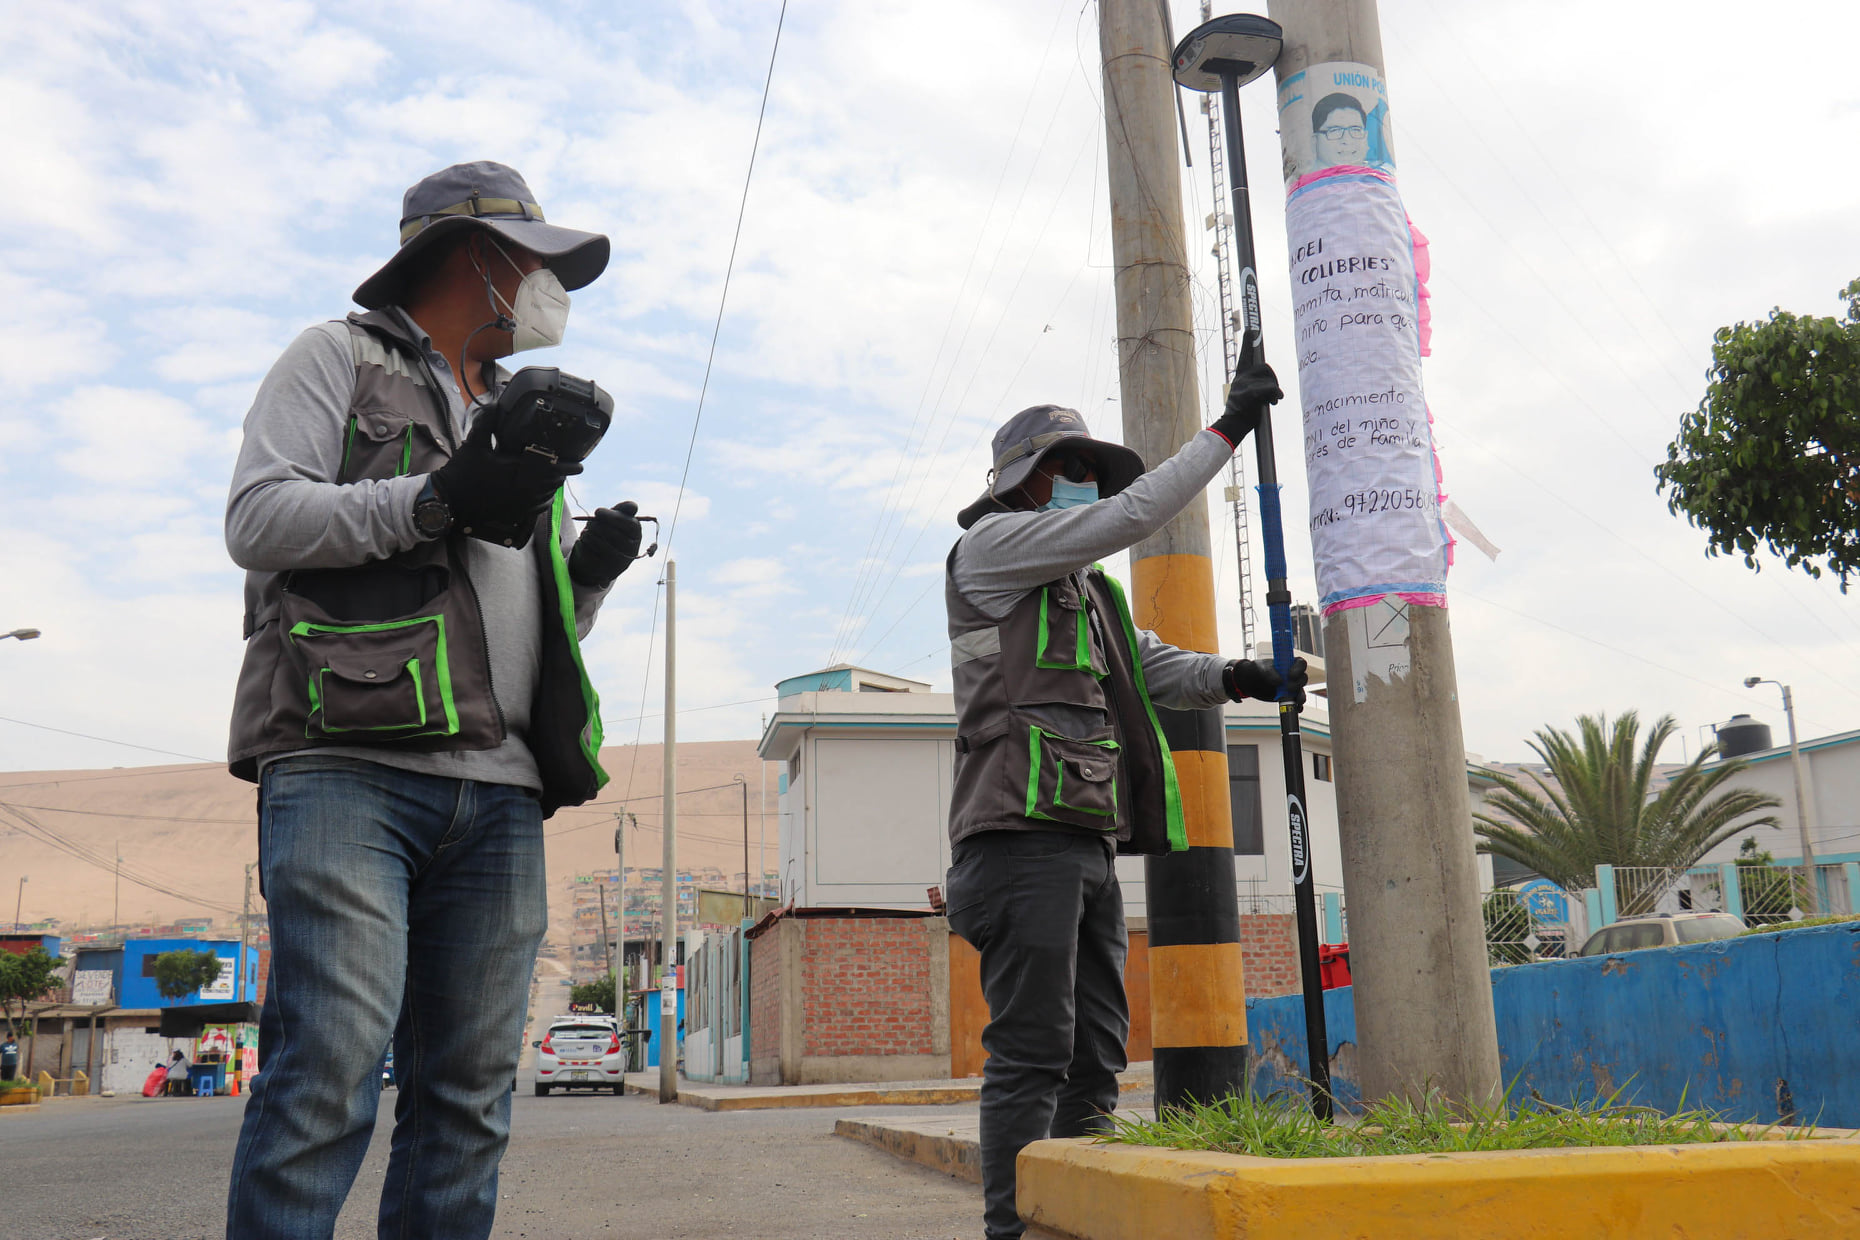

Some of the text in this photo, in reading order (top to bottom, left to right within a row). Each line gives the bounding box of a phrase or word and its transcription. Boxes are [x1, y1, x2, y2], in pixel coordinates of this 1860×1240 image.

[1333, 71, 1370, 89] UNIÓN
[1246, 283, 1260, 331] SPECTRA
[1301, 318, 1328, 342] niño
[1340, 312, 1383, 331] para
[1314, 385, 1405, 416] nacimiento
[1331, 419, 1350, 436] del
[1359, 417, 1399, 432] niño
[1337, 435, 1356, 449] de
[1371, 430, 1421, 448] familia
[1290, 813, 1304, 866] SPECTRA
